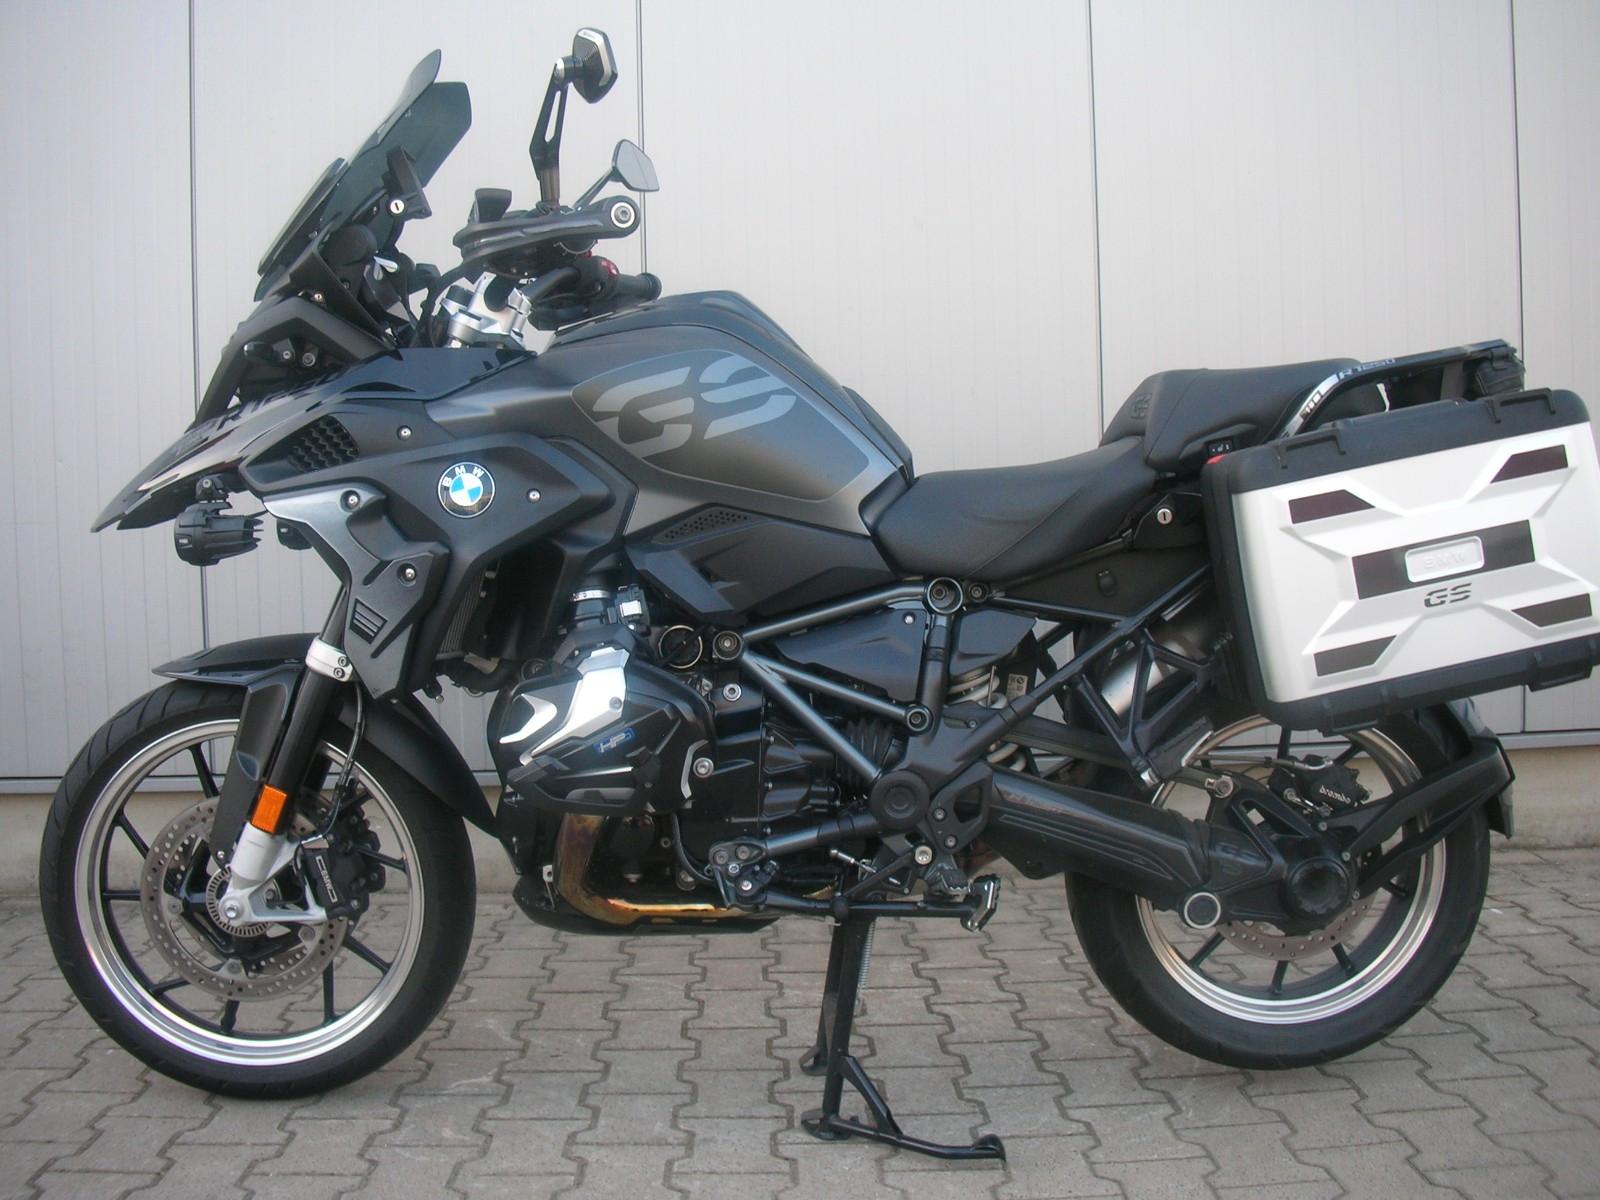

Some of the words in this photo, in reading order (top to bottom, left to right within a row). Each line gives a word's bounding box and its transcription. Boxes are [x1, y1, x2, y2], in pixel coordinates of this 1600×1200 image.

[592, 354, 797, 459] GS
[441, 464, 485, 488] BMW
[1423, 582, 1473, 608] GS
